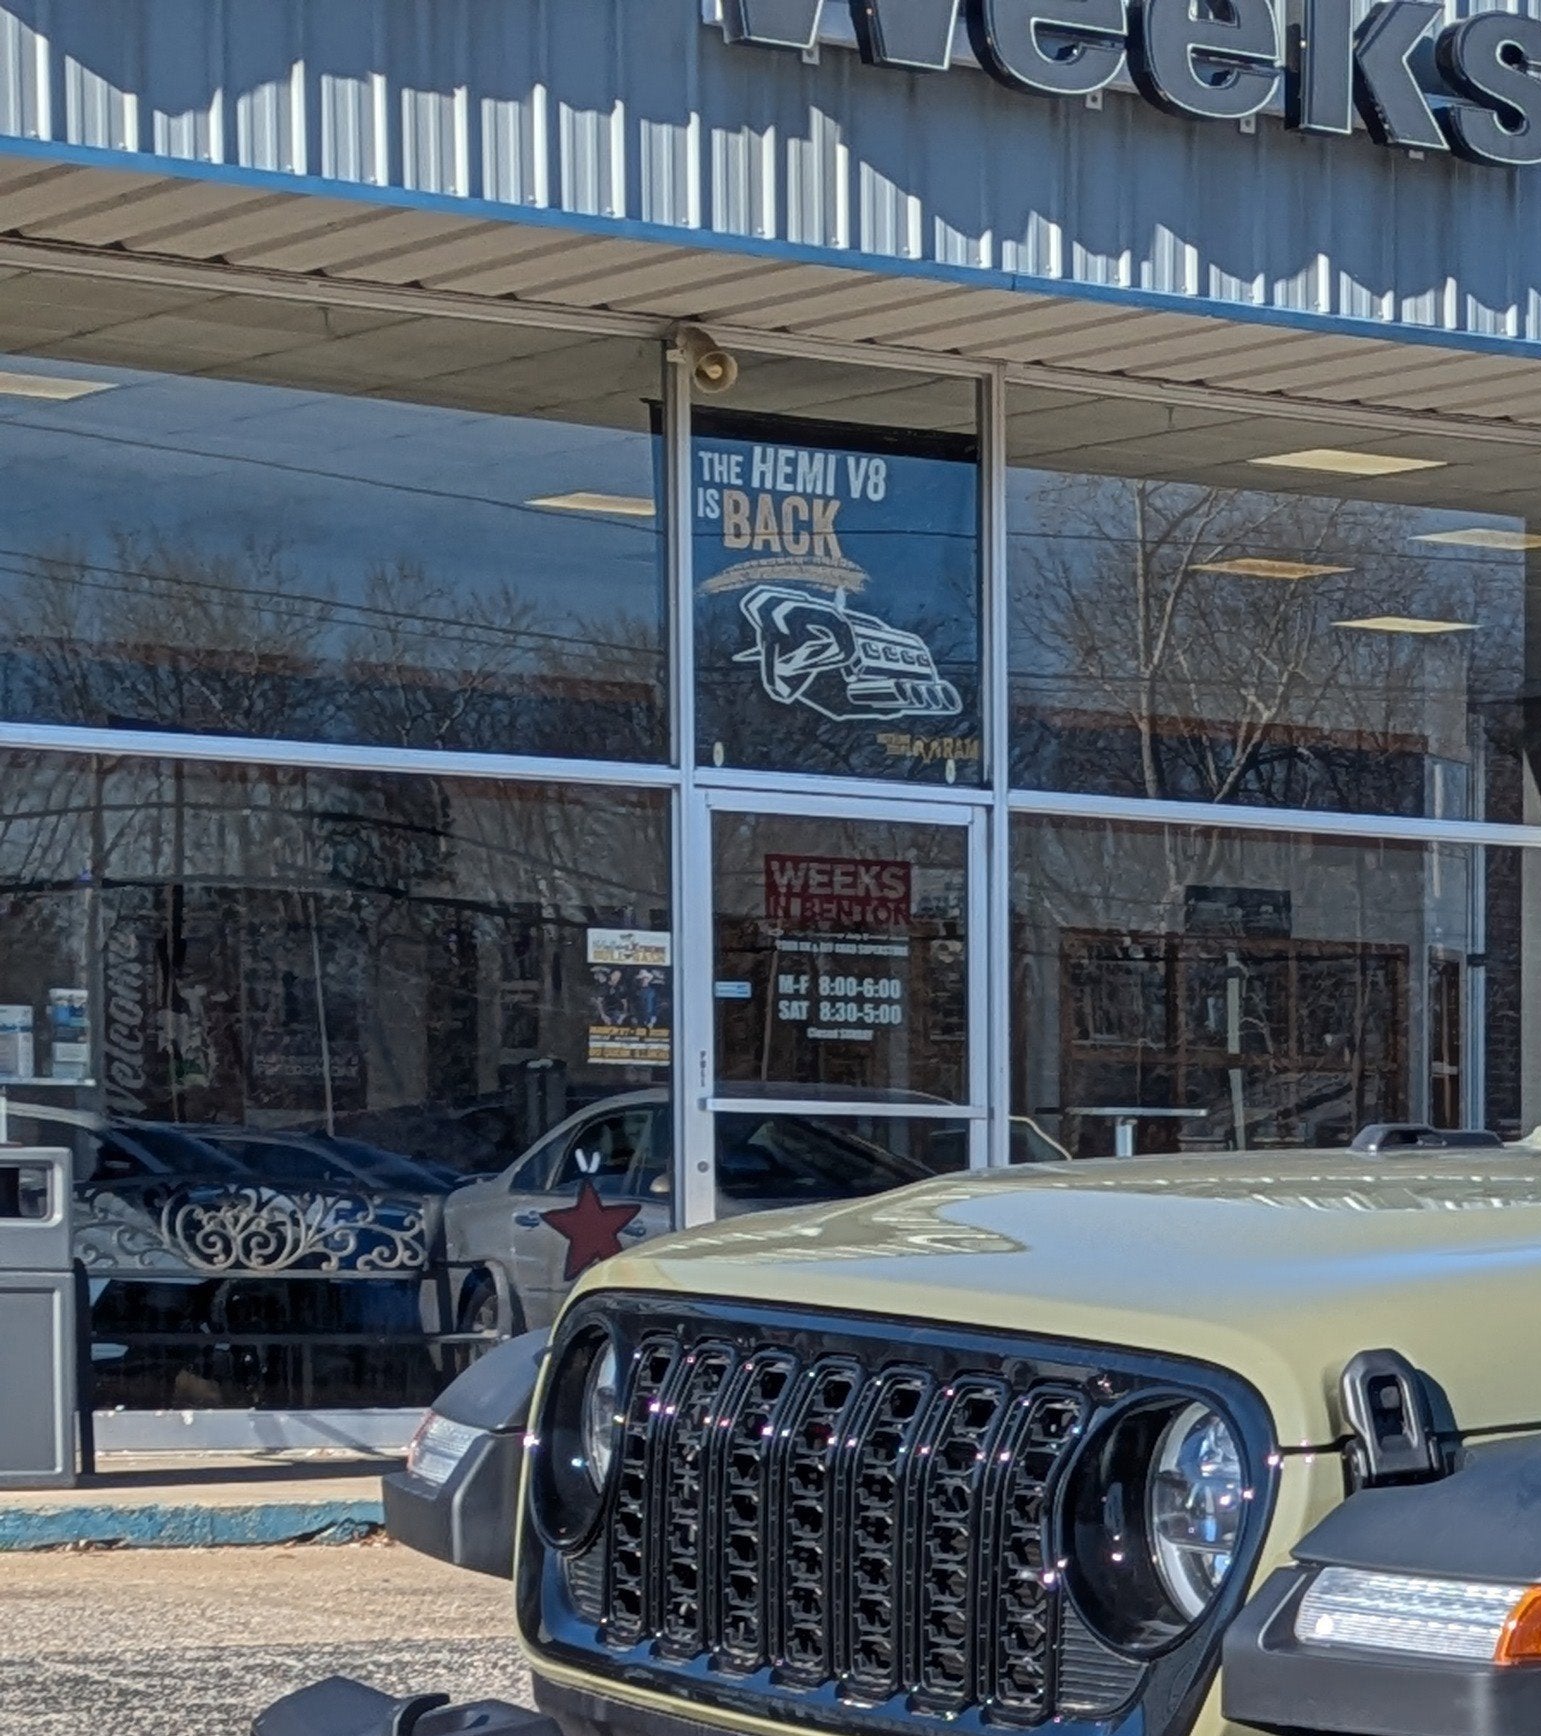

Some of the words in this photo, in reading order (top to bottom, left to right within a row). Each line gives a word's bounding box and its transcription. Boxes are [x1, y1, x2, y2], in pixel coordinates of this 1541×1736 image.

[698, 450, 744, 486] THE
[751, 445, 837, 497] HEMI
[847, 455, 887, 502] V8
[697, 487, 721, 519] IS
[722, 489, 842, 561] BACK
[769, 860, 909, 900] WEEKS
[777, 974, 811, 995] M-F
[818, 974, 902, 1000] 8:00-6:00
[777, 1000, 810, 1021] SAT
[819, 1001, 903, 1025] 8:30-5:00
